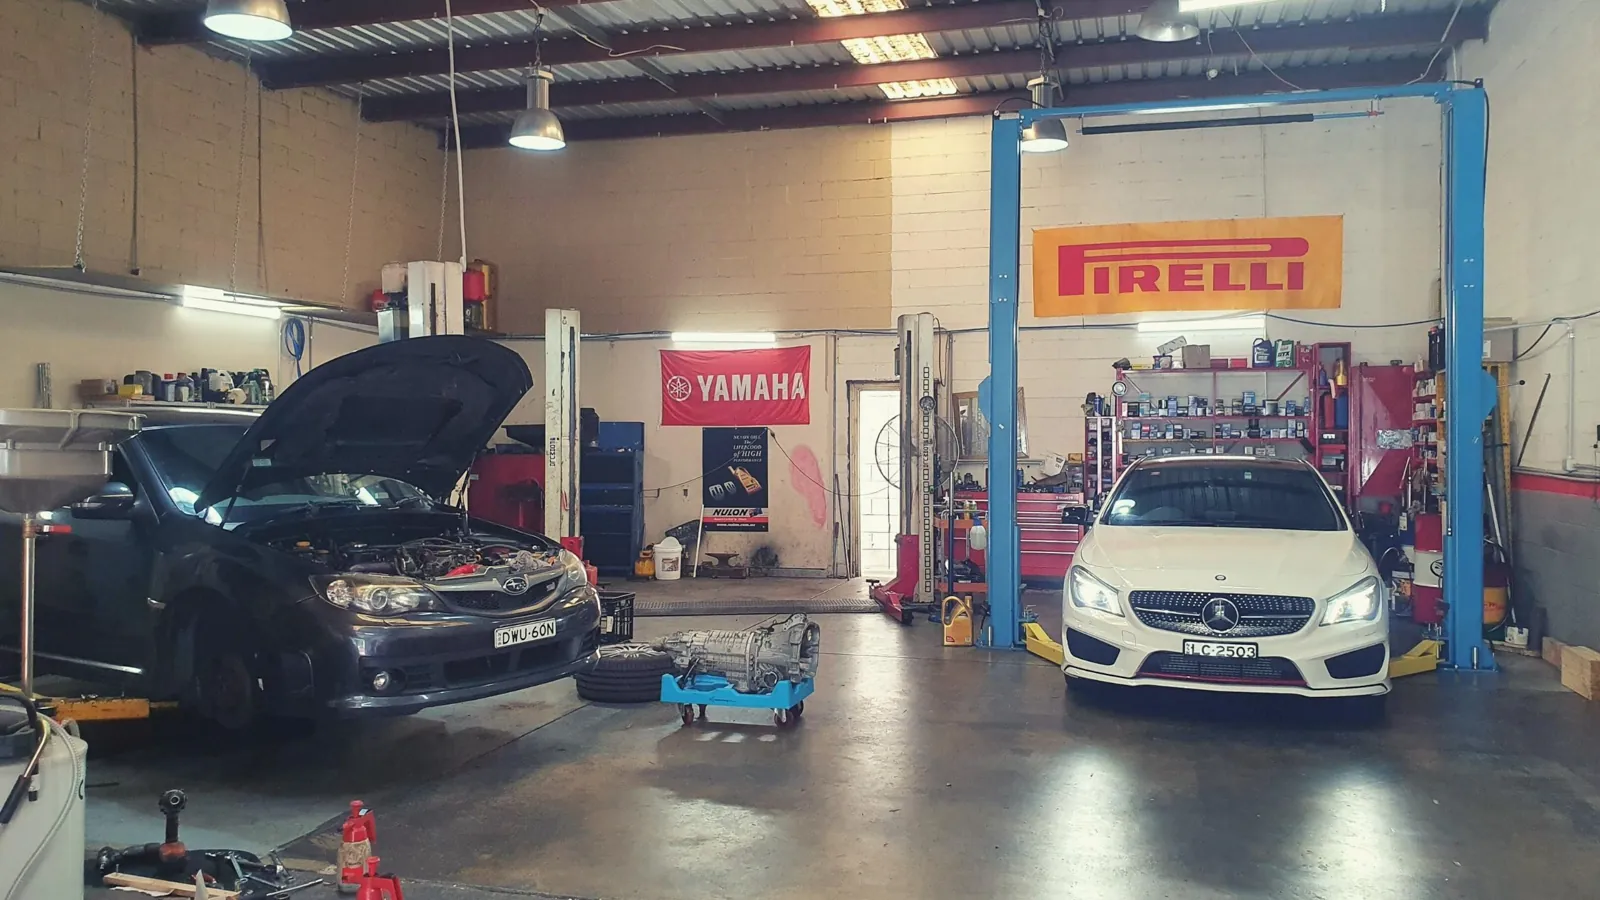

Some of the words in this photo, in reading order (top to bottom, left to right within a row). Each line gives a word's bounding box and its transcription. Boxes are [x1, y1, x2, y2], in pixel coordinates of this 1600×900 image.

[1058, 237, 1309, 296] PIRELLI
[697, 372, 806, 402] YAMAHA
[712, 508, 749, 516] NULON
